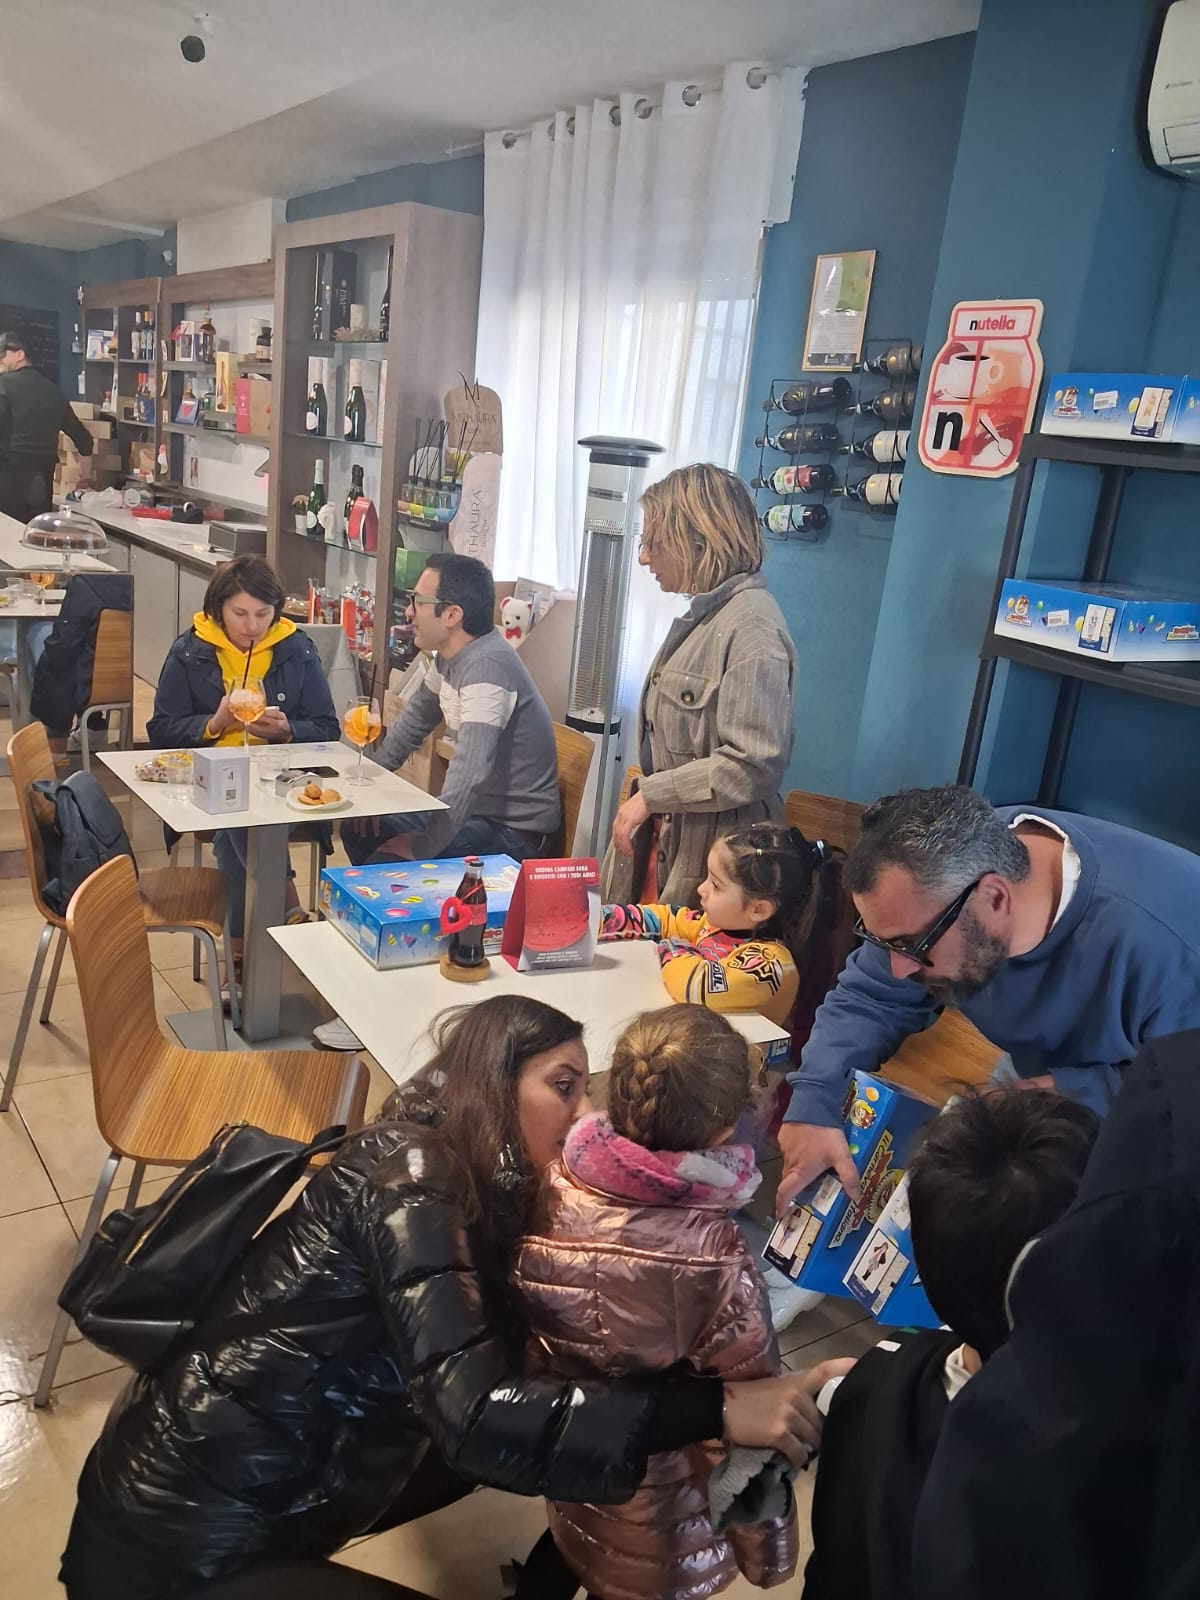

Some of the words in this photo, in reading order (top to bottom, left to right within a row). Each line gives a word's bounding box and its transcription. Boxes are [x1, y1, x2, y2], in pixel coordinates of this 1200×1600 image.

[969, 315, 1016, 331] nutella
[932, 411, 964, 451] n
[468, 488, 482, 553] THAURA
[860, 1146, 887, 1193] Carneva
